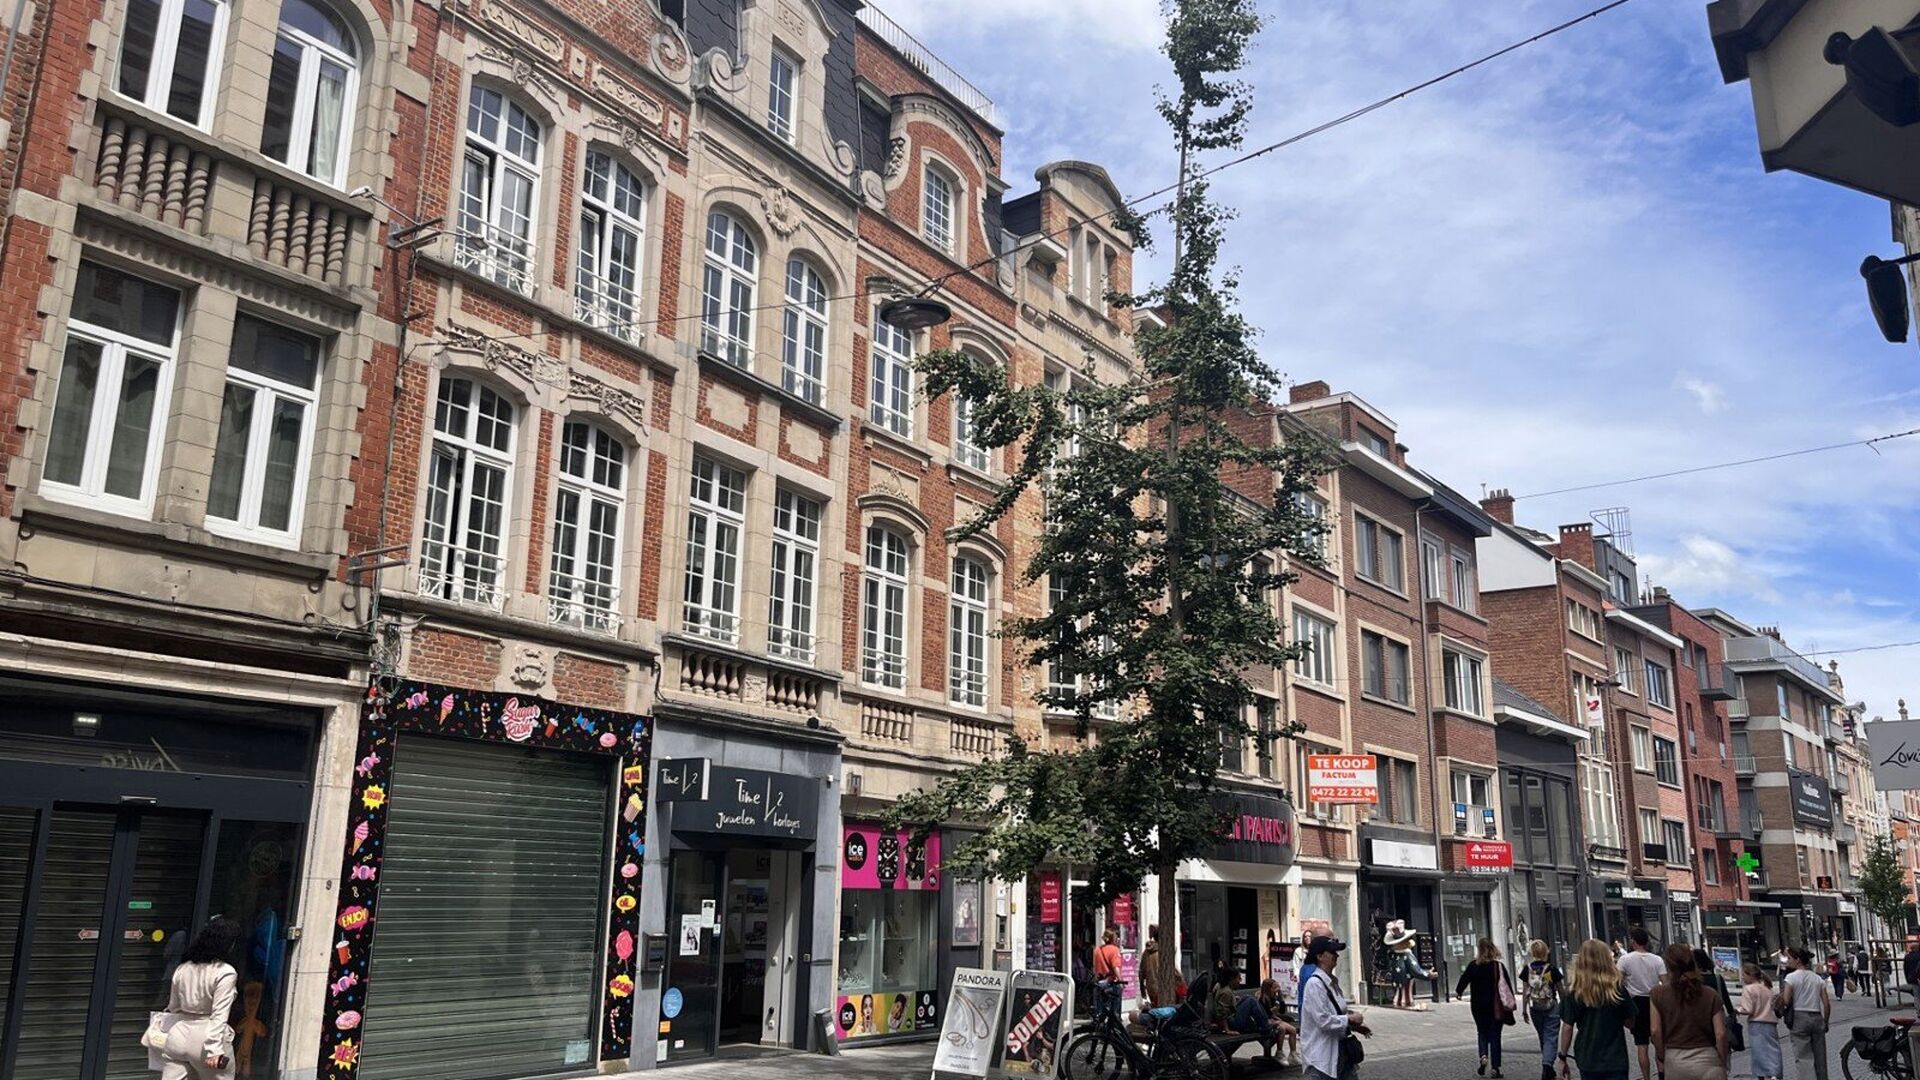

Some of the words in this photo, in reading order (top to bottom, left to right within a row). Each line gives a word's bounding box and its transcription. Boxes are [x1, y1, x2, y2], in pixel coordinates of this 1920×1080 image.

[491, 9, 551, 51] ANNO
[606, 80, 648, 114] 1920
[502, 697, 541, 722] Sugar
[1315, 758, 1330, 768] TE
[1333, 758, 1369, 769] KOOP
[661, 768, 680, 785] Time
[735, 778, 760, 804] Time
[1311, 788, 1335, 797] 0472
[1337, 788, 1348, 797] 22
[1350, 788, 1363, 797] 22
[1364, 788, 1376, 797] 04
[1244, 815, 1281, 843] PARIS
[848, 841, 864, 856] ice
[957, 973, 1002, 987] PANDORA
